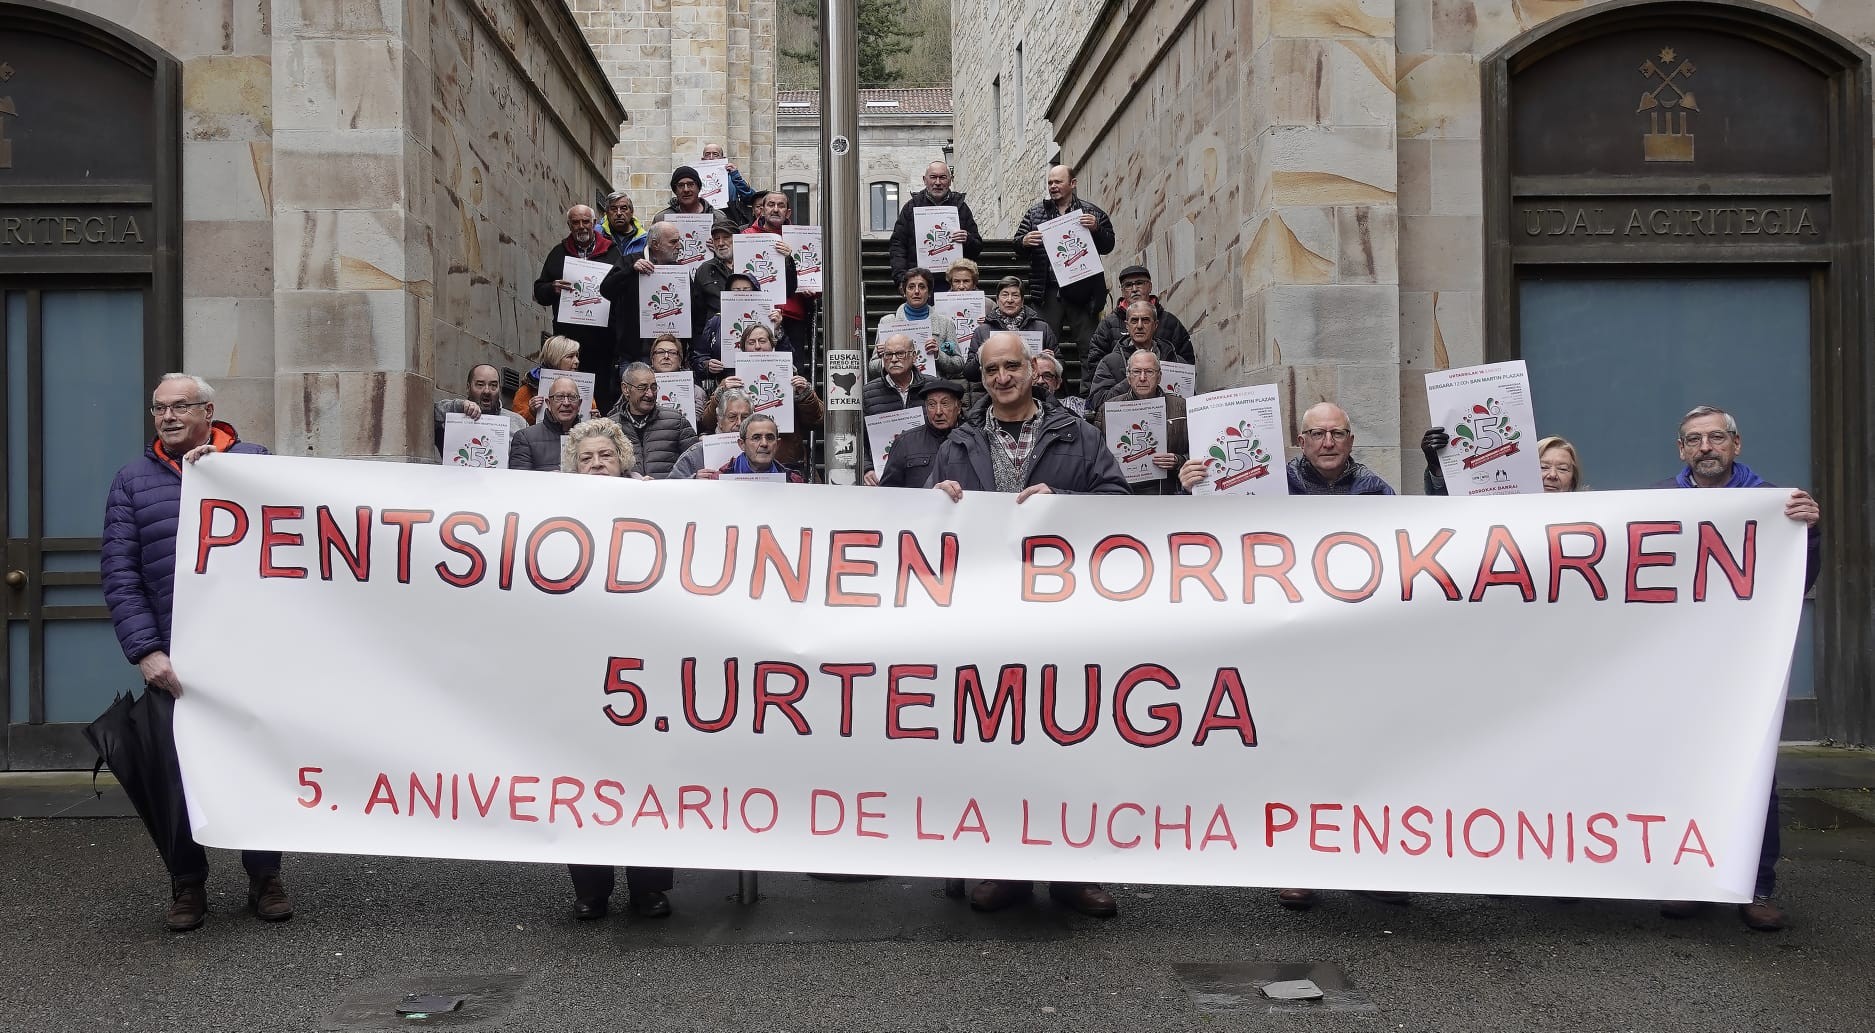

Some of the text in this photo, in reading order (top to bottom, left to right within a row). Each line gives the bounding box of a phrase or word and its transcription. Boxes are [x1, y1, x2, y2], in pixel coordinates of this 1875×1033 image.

[1, 215, 144, 244] RITEGIA
[1523, 208, 1819, 236] UDAL AGIRITEGIA
[829, 353, 861, 361] EUSKAL
[1482, 375, 1502, 383] MARTIN
[1502, 372, 1524, 380] PLAZAN
[1236, 398, 1255, 406] MARTIN
[1474, 416, 1503, 457] 5
[1226, 439, 1254, 479] 5
[194, 498, 1758, 607] PENTSIODUNEN BORROKAREN
[297, 766, 1715, 868] 5. ANIVERSARIO DE LA LUCHA PENSIONISTA
